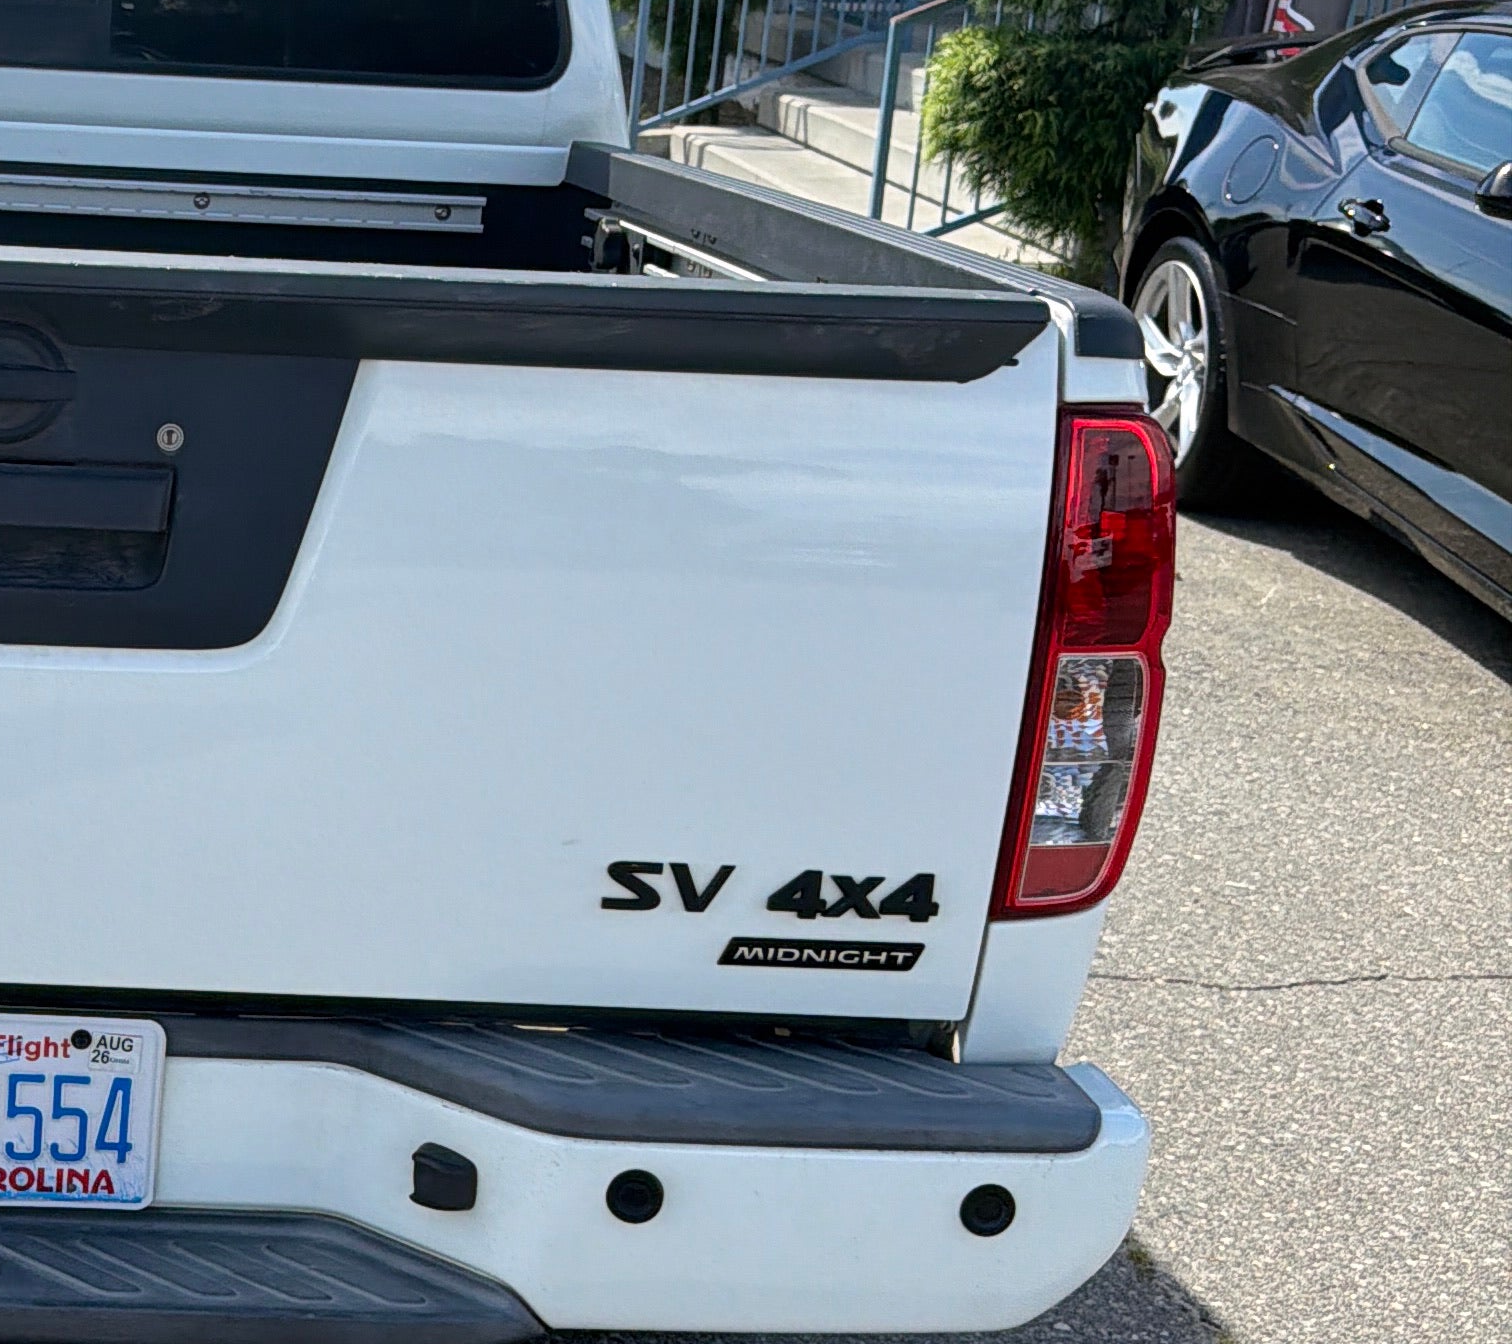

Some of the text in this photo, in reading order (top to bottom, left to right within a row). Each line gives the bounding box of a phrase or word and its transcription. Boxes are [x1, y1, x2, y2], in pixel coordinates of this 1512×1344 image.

[601, 861, 737, 913] SV
[733, 945, 914, 966] MIDNIGHT
[96, 1035, 134, 1053] AUG
[91, 1049, 111, 1065] 26
